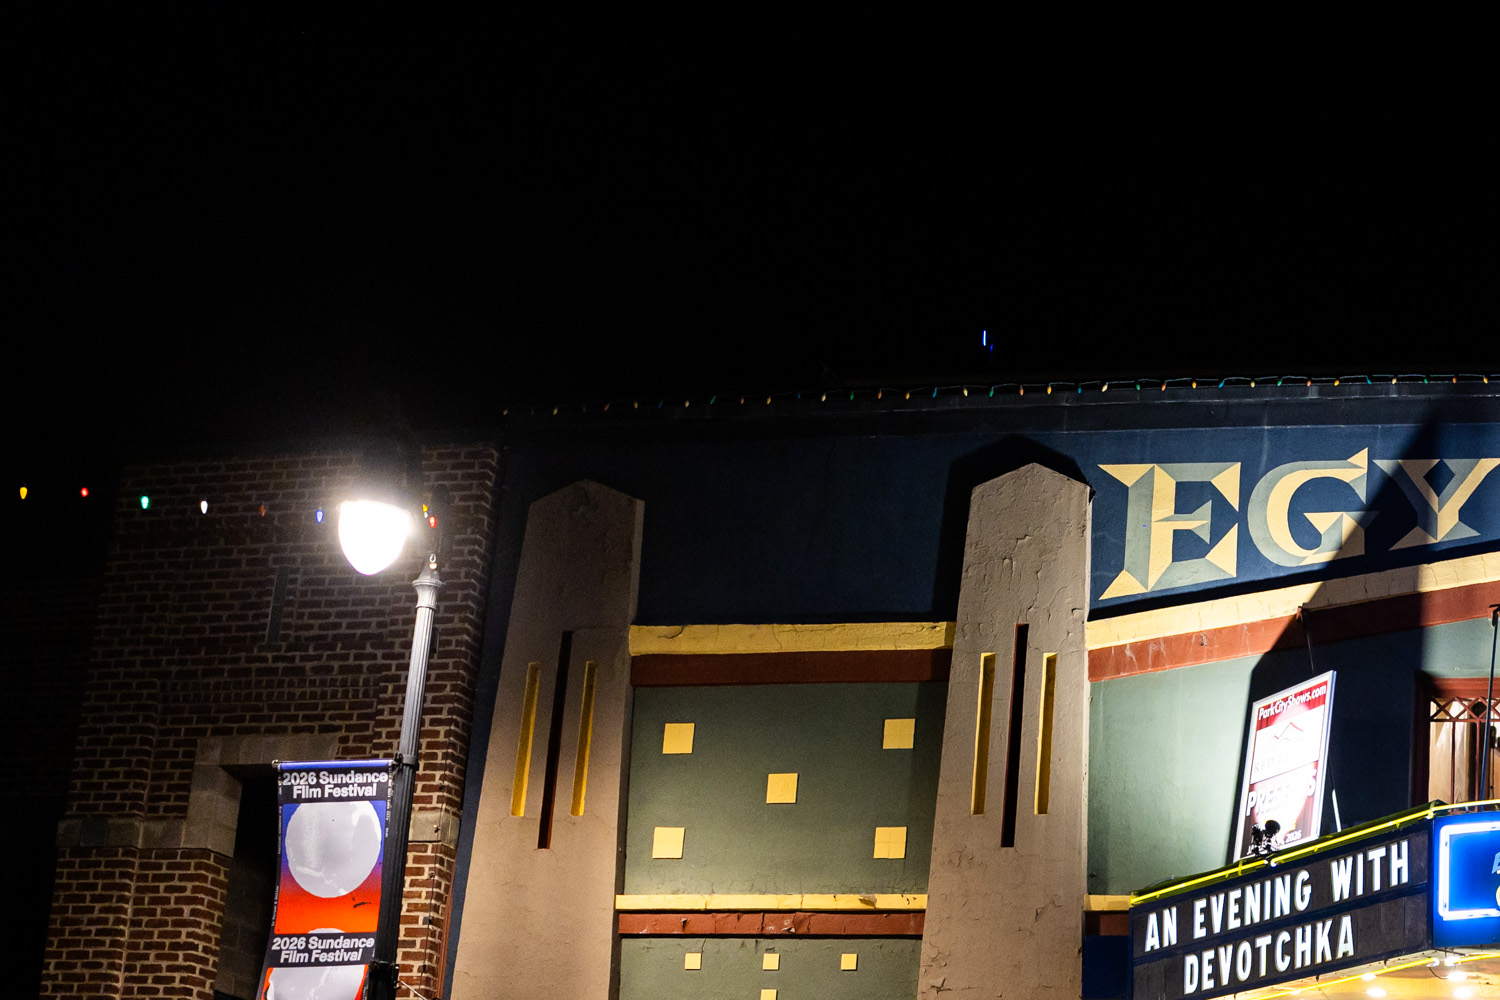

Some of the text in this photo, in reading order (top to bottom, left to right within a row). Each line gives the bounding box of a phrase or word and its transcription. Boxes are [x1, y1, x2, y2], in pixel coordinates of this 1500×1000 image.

[1258, 684, 1327, 721] ParkCityShows.com
[282, 770, 389, 786] 2026 Sundance
[293, 783, 378, 799] Film Festival
[1145, 839, 1409, 952] AN EVENING WITH
[271, 936, 376, 951] 2026 Sundance
[280, 949, 363, 963] Film Festival
[1183, 914, 1355, 995] DEVOTCHKA
